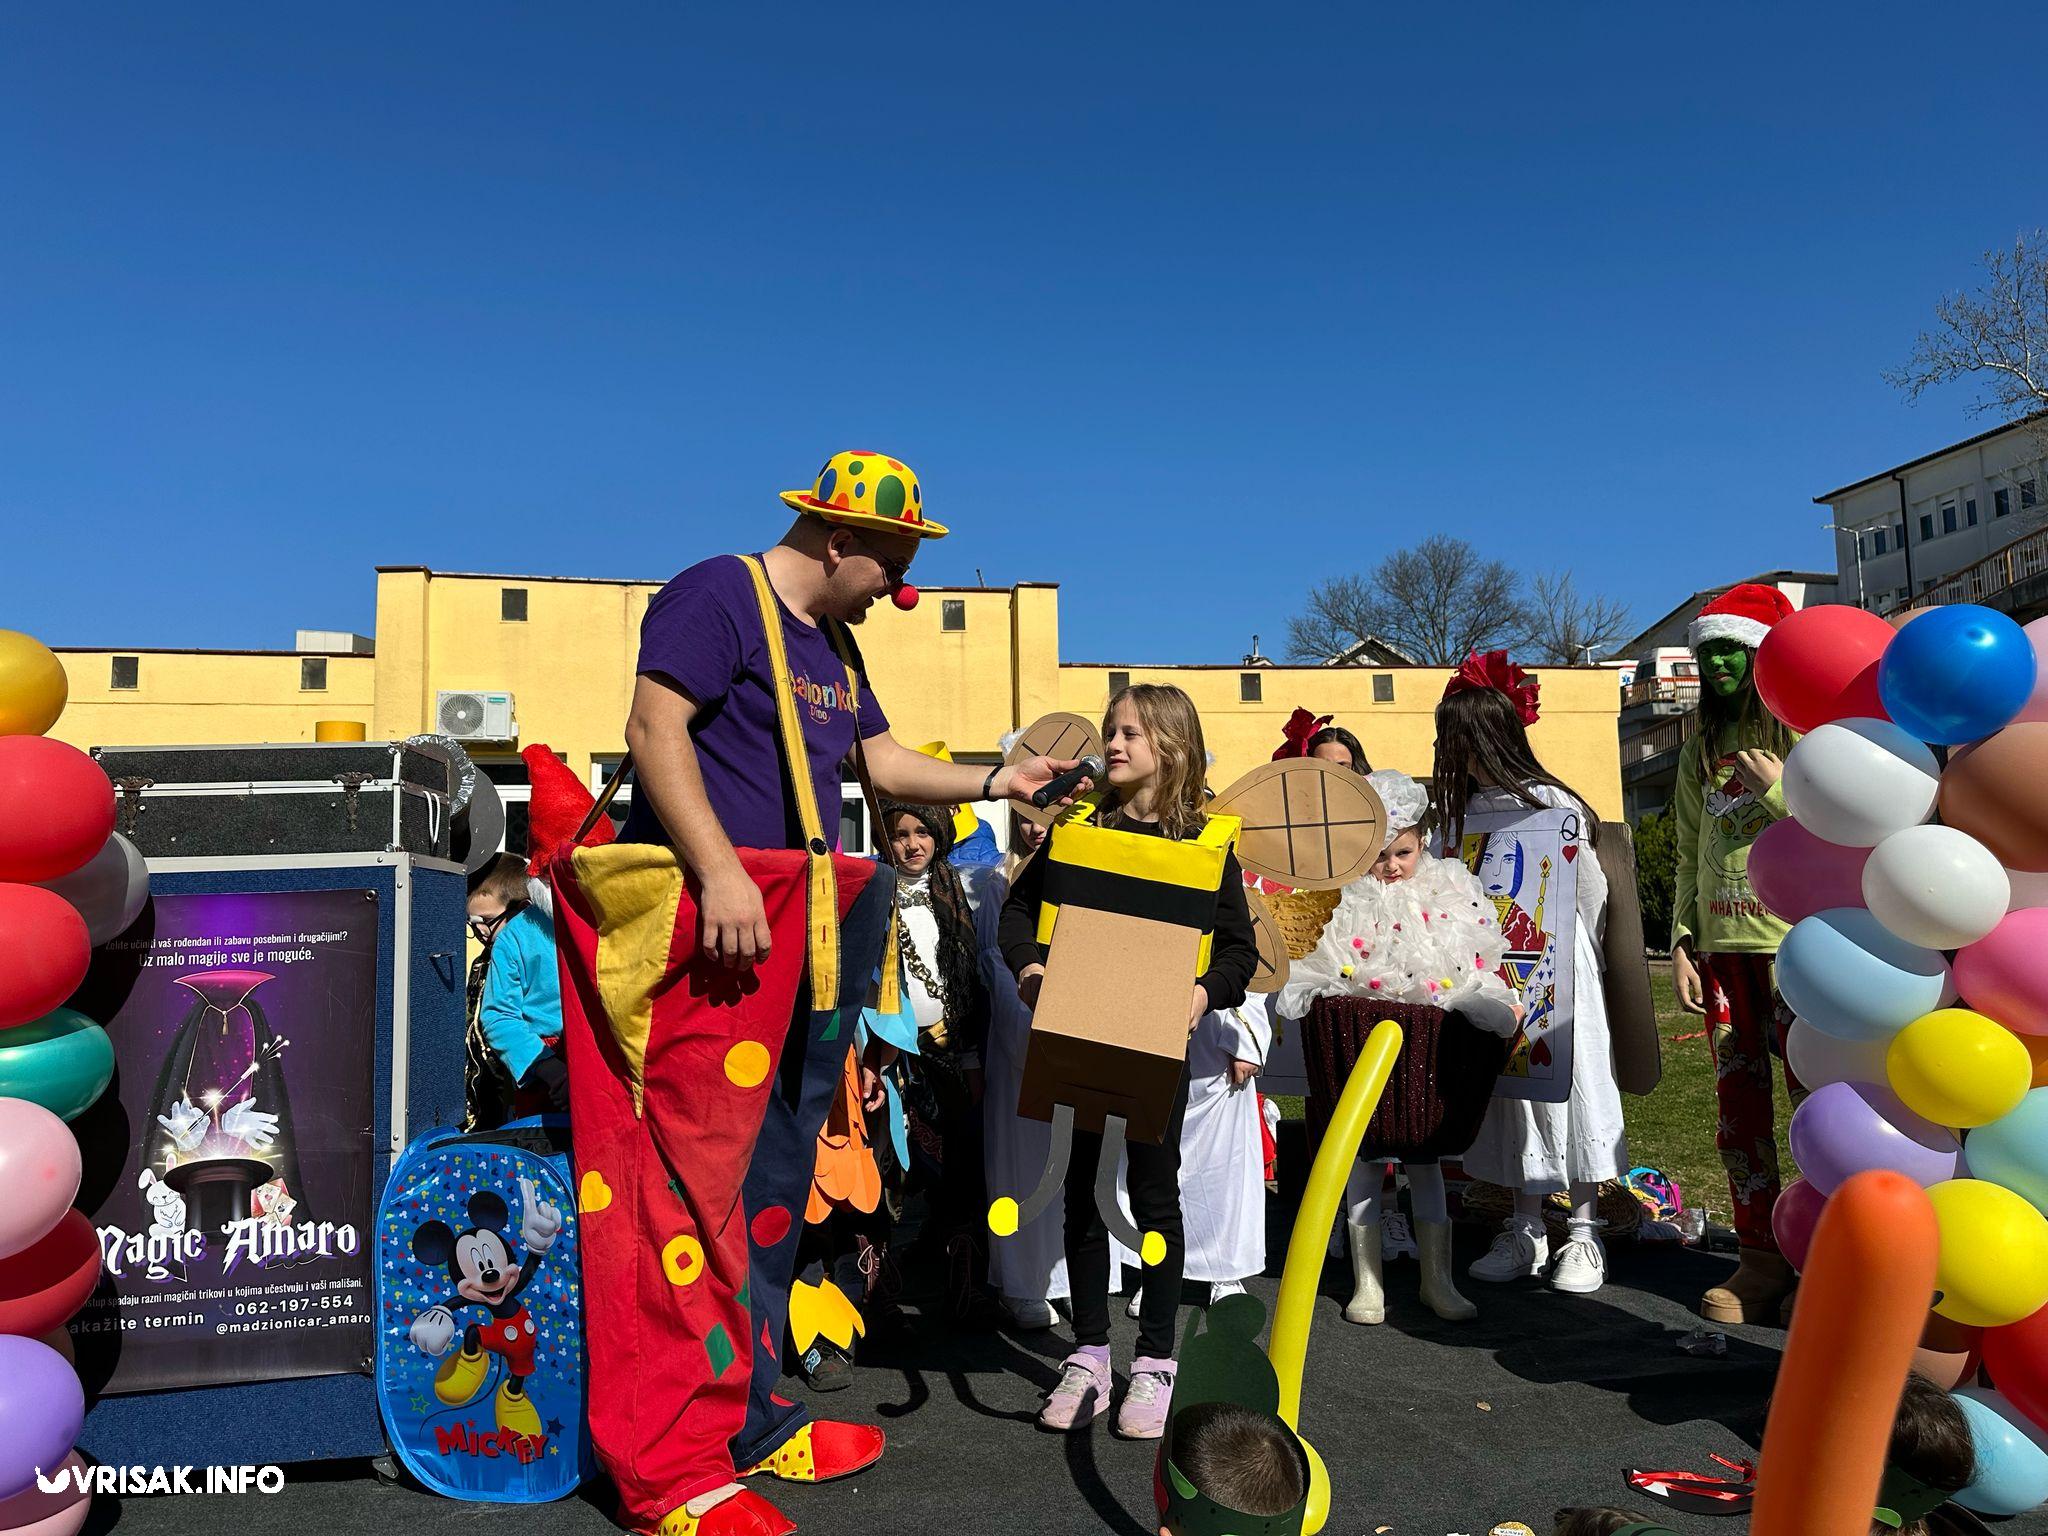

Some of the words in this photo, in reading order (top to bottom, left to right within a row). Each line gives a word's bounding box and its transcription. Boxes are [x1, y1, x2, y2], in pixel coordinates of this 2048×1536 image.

[1560, 814, 1579, 841] Q
[158, 938, 172, 948] vaš
[173, 937, 212, 947] rođendan
[214, 936, 222, 946] ili
[224, 936, 251, 946] zabavu
[253, 934, 292, 946] posebnim
[298, 931, 348, 944] drugačijim!?
[140, 953, 153, 967] Uz
[156, 952, 185, 966] malo
[188, 951, 227, 967] magije
[231, 951, 250, 963] sve
[252, 950, 264, 965] je
[267, 946, 315, 964] moguće.
[221, 1216, 356, 1276] Amaro
[108, 1294, 139, 1307] spadaju
[141, 1292, 162, 1303] razni
[164, 1290, 197, 1303] magični
[199, 1288, 225, 1300] trikovi
[227, 1289, 233, 1298] u
[235, 1285, 263, 1298] kojima
[264, 1282, 303, 1295] učestvuju
[311, 1280, 327, 1291] vaši
[329, 1277, 363, 1290] mališani.
[235, 1295, 354, 1316] 062-197-554
[69, 1317, 137, 1334] akažite
[144, 1312, 204, 1328] termin
[216, 1314, 371, 1335] @madzionicar_amaro
